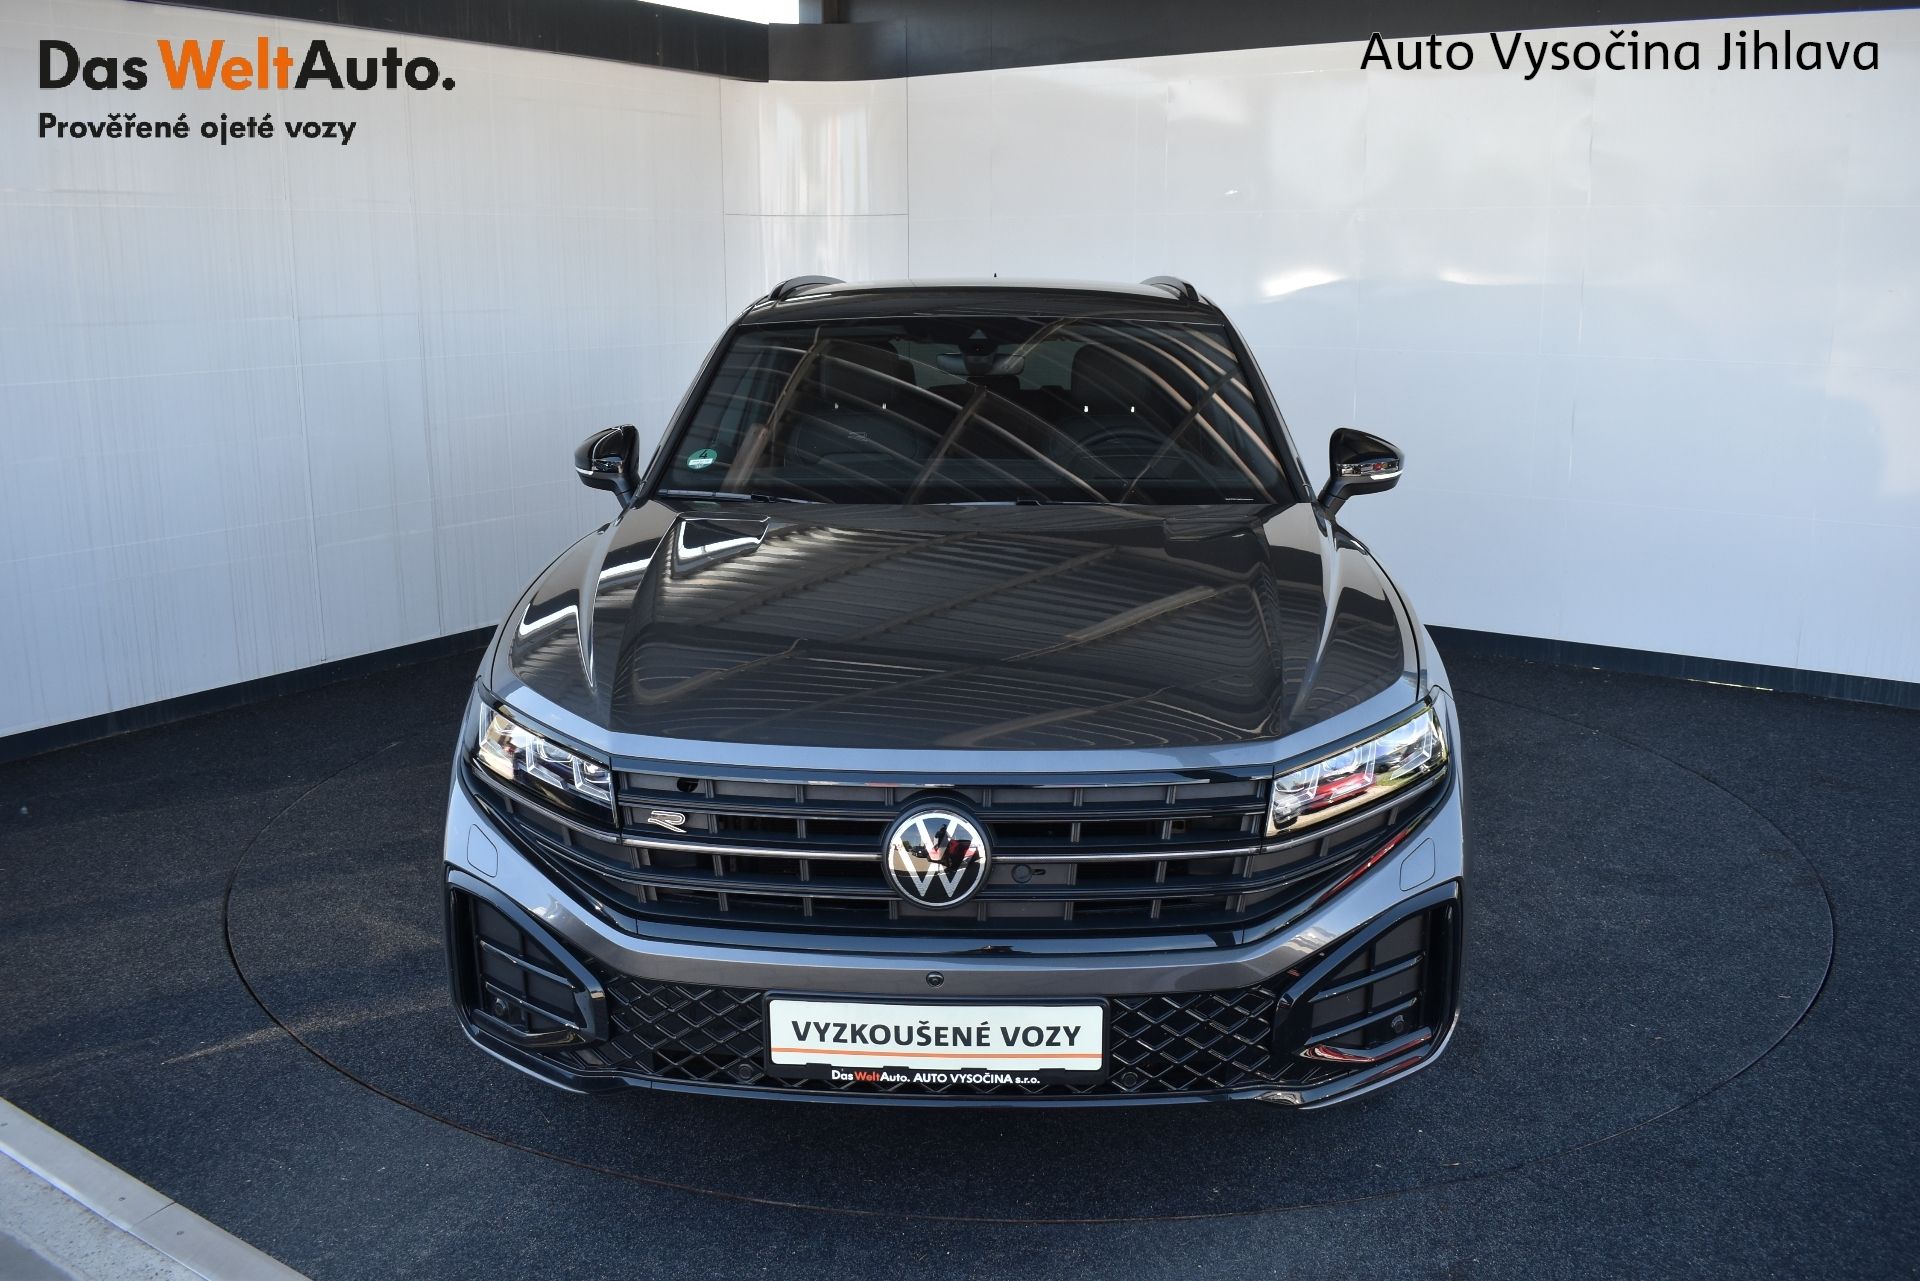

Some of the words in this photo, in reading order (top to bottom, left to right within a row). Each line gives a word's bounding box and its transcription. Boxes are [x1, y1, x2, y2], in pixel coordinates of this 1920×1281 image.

[699, 450, 708, 459] 4
[791, 1020, 992, 1048] VYZKOUŠENÉ
[999, 1025, 1081, 1048] VOZY
[831, 1069, 854, 1081] Das
[854, 1071, 911, 1083] WeltAuto.
[912, 1072, 948, 1084] AUTO
[949, 1072, 1014, 1085] VYSOČINA
[1015, 1076, 1041, 1084] s.r.o.
